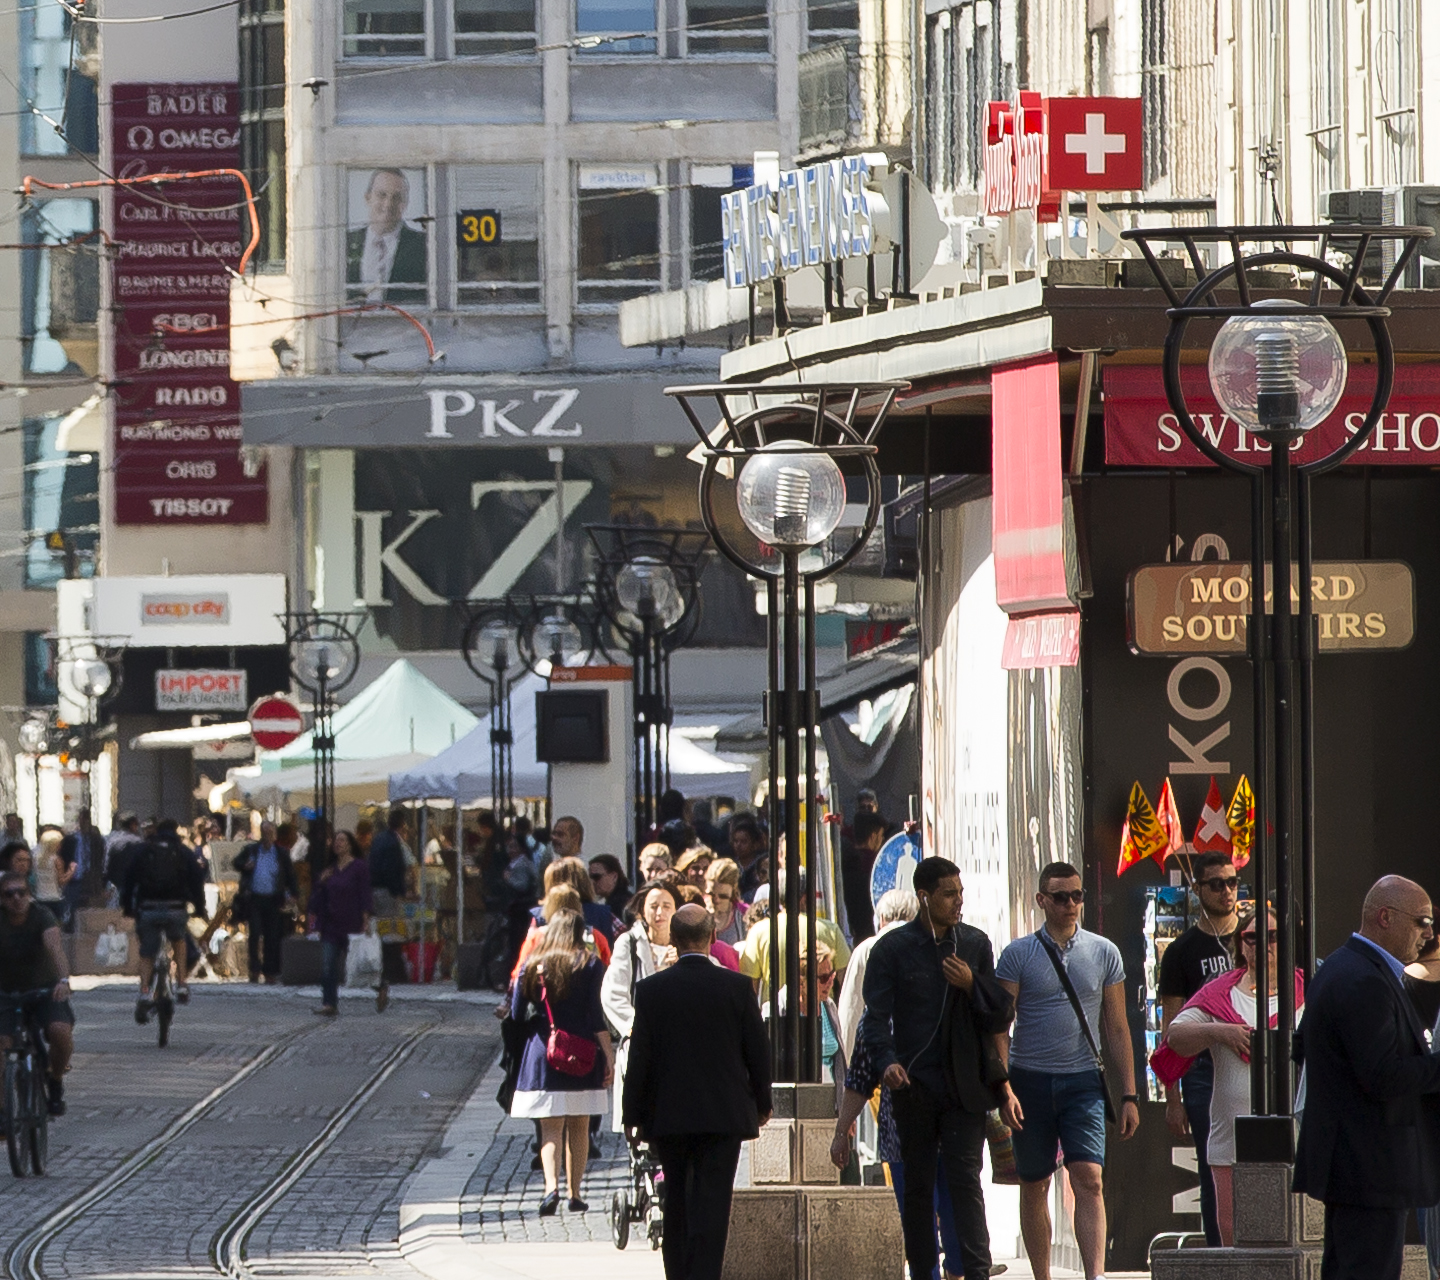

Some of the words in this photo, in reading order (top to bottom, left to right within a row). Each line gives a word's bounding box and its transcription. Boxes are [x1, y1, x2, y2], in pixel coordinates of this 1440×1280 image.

[147, 95, 227, 115] BADER
[463, 215, 496, 244] 30
[720, 182, 777, 289] RENTES
[778, 152, 872, 272] GENEVOISES
[119, 241, 189, 258] MAURICE
[155, 386, 227, 406] RADO
[121, 424, 211, 441] RAYMOND
[165, 460, 217, 479] ORIS
[149, 497, 234, 517] TISSOT
